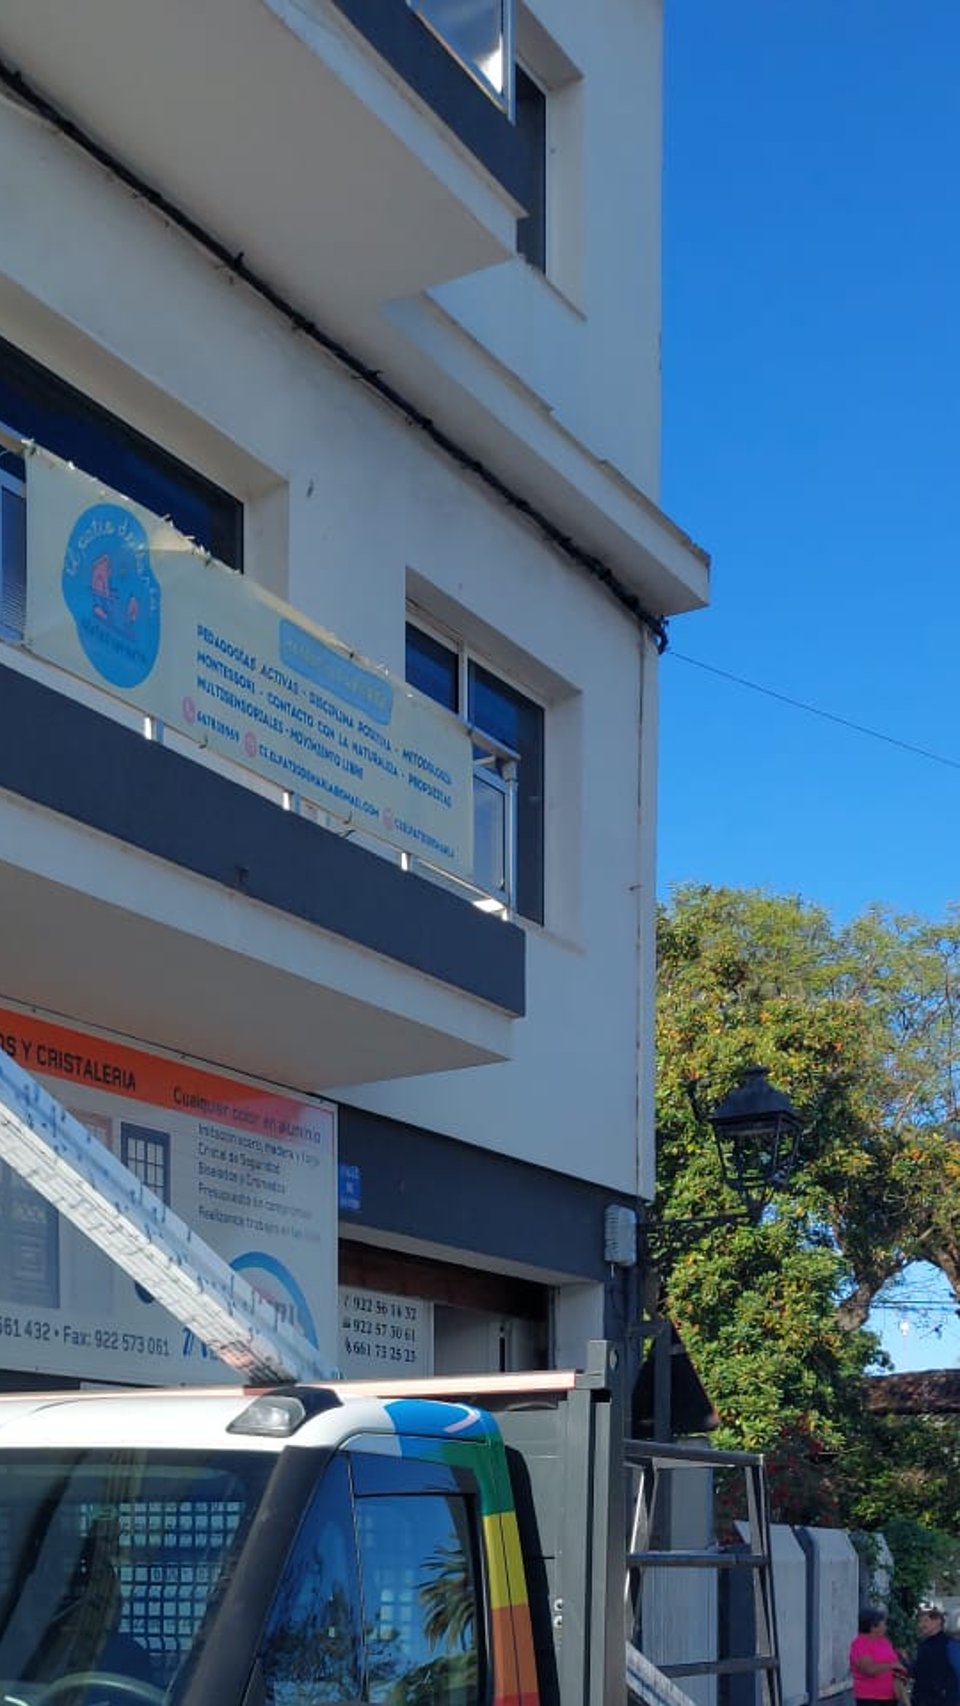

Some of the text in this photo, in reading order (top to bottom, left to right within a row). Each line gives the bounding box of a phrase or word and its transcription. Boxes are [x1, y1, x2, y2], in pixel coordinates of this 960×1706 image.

[260, 664, 299, 695] ACTIVAS
[197, 651, 255, 694] MONTESSORI
[267, 692, 314, 728] CONTACTO
[318, 721, 335, 739] CON
[340, 733, 349, 749] LA
[21, 1038, 33, 1061] Y
[37, 1044, 137, 1091] CRISTALERIA
[173, 1086, 228, 1116] Cualquier
[353, 1297, 373, 1312] 922
[25, 1320, 51, 1342] 432
[95, 1330, 119, 1351] 922
[123, 1334, 144, 1353] 573
[147, 1337, 171, 1357] 061
[353, 1318, 373, 1334] 922
[375, 1322, 387, 1336] 57
